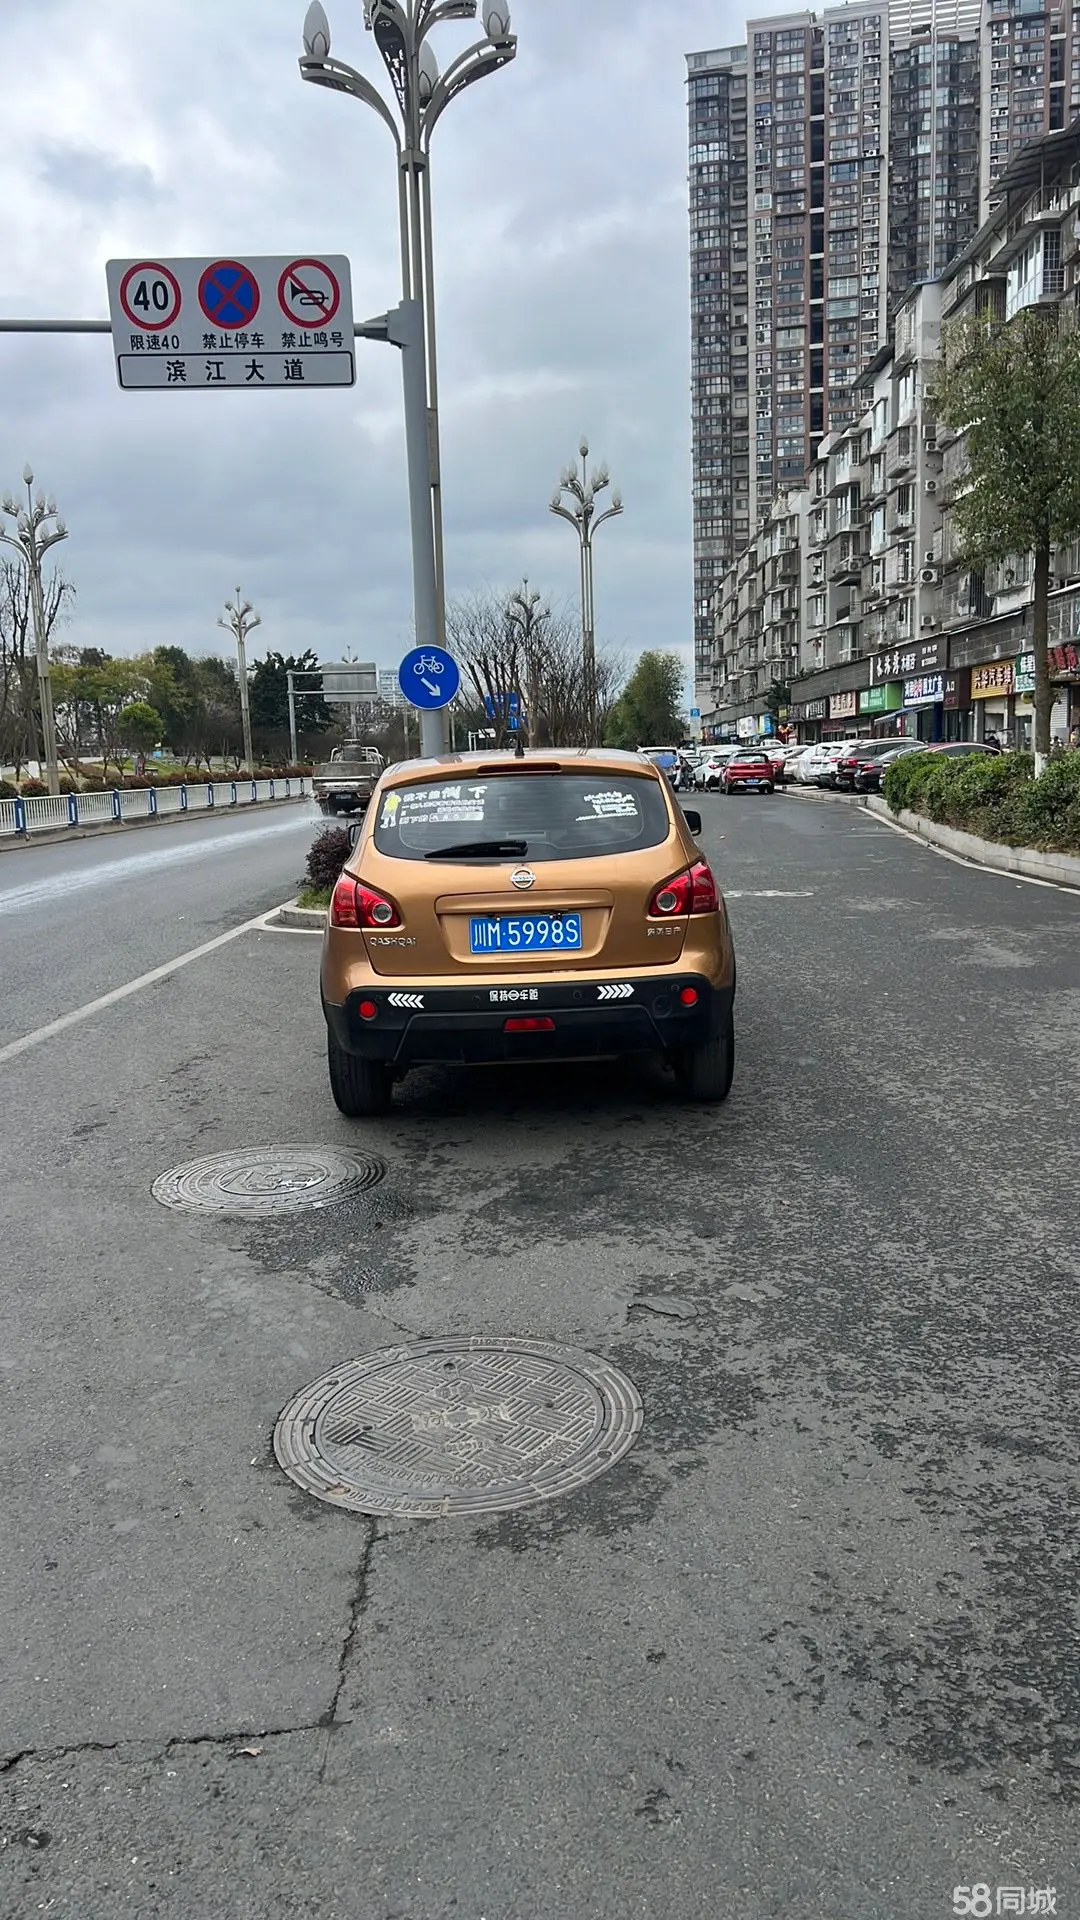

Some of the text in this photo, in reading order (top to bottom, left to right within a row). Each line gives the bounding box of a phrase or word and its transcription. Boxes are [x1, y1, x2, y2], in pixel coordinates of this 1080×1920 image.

[133, 280, 169, 311] 40
[130, 334, 180, 351] 限速40
[202, 332, 265, 349] 禁止停车
[281, 332, 344, 348] 禁止鸣号
[166, 359, 305, 382] 滨江大道
[474, 919, 579, 947] 川M·5998S
[369, 937, 416, 947] QASHQAI
[489, 988, 539, 1002] 保持 车距
